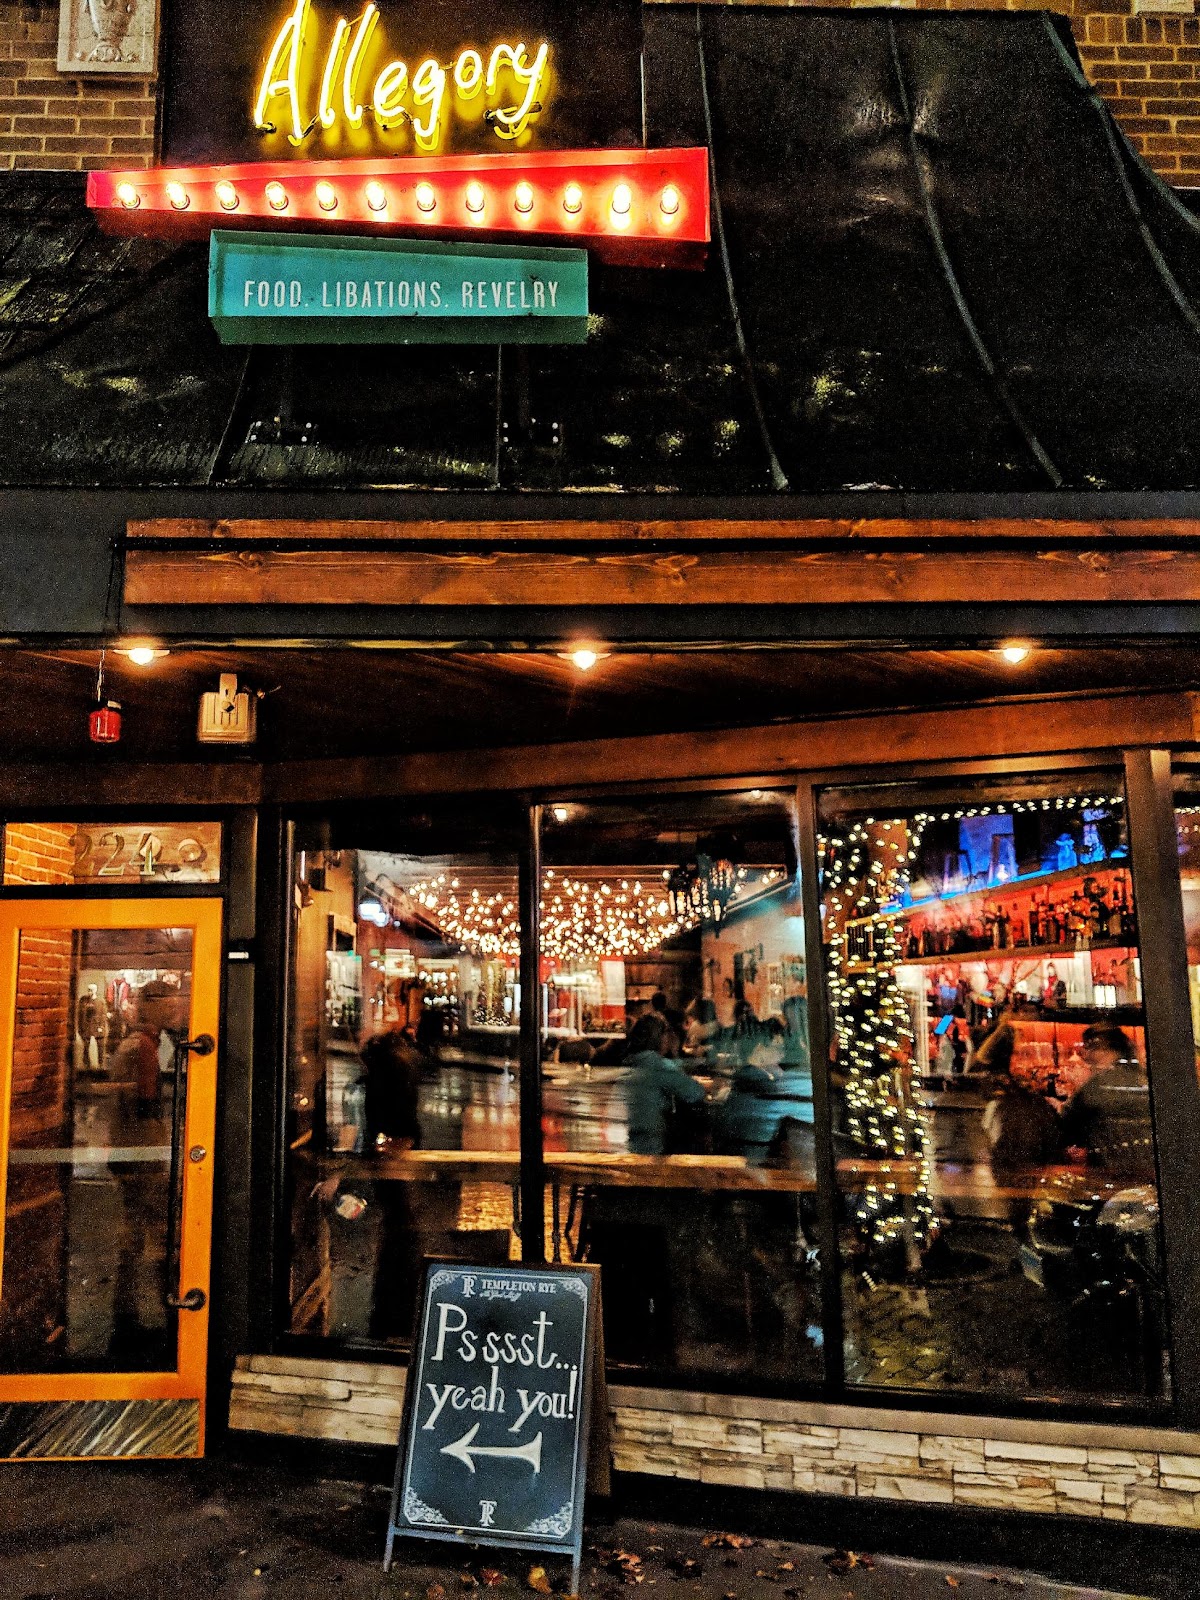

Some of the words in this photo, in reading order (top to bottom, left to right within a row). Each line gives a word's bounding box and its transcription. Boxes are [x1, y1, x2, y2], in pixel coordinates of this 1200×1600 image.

[253, 0, 549, 147] Allegory
[243, 280, 309, 308] FOOD.
[322, 281, 449, 309] LIBATIONS.
[461, 281, 559, 309] REVELRY
[481, 1279, 536, 1292] TEMPLETON
[538, 1282, 557, 1294] RYE
[422, 1365, 505, 1430] yeah
[507, 1365, 578, 1432] you!
